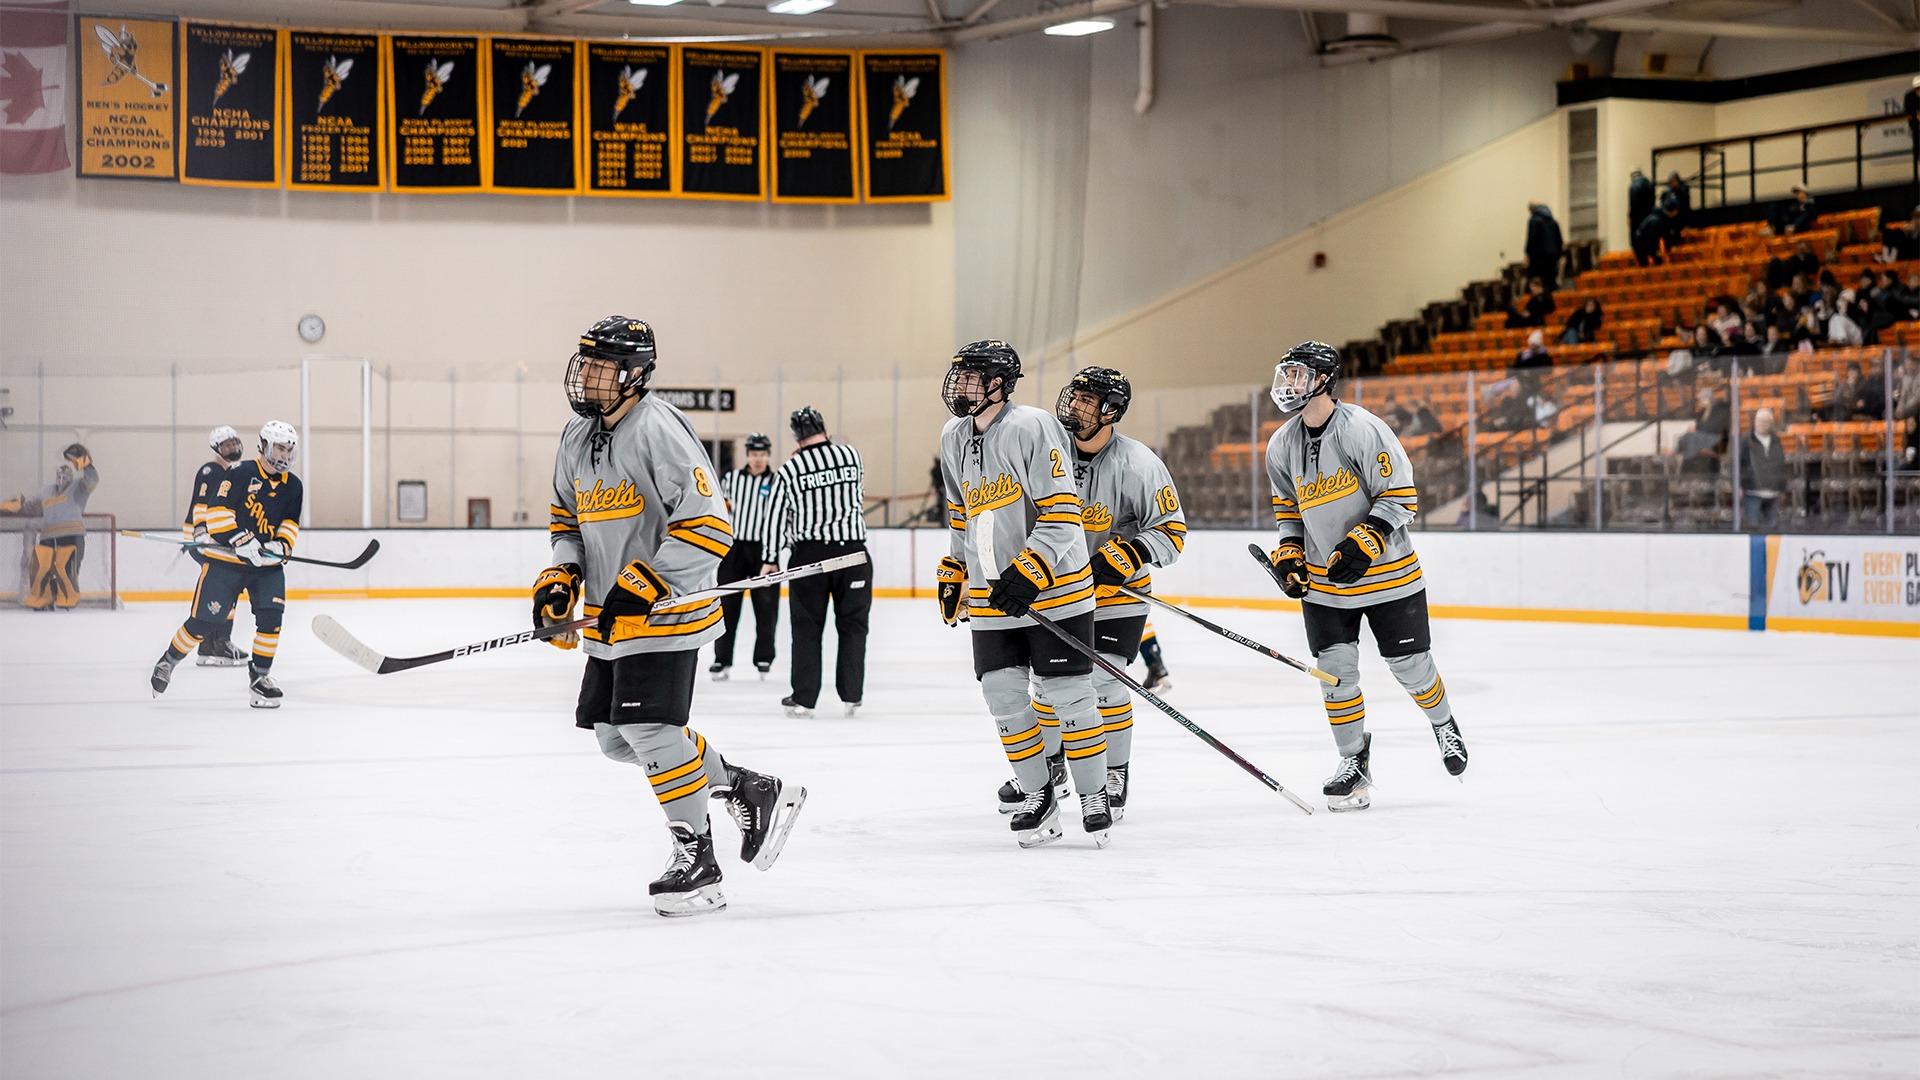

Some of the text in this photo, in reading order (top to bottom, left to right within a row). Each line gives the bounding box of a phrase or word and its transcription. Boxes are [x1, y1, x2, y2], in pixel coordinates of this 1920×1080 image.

[190, 28, 274, 41] YELLOWJACKETS
[87, 101, 169, 111] MEN'S HOCKEY
[213, 108, 250, 119] NCHA
[109, 115, 147, 125] NCAA
[191, 115, 271, 131] CHAMPIONS
[317, 115, 353, 126] NCAA
[431, 118, 473, 126] PLAYOFF
[93, 126, 164, 137] NATIONAL
[301, 125, 370, 134] FROZEN FOUR
[399, 126, 476, 136] CHAMPIONS
[496, 127, 571, 139] CHAMPIONS
[613, 123, 647, 132] WIAC
[235, 130, 264, 141] 2001
[593, 130, 667, 142] CHAMPIONS
[685, 133, 757, 147] CHAMPIONS
[86, 138, 170, 150] CHAMPIONS
[780, 138, 848, 149] CHAMPIONS
[101, 154, 156, 169] 2002
[340, 163, 369, 173] 2001
[698, 392, 705, 408] 1
[720, 392, 731, 408] 2
[1050, 448, 1066, 478] 2
[1377, 451, 1393, 478] 3
[693, 467, 713, 497] 8
[799, 466, 858, 491] FRIEDLIEB
[1155, 485, 1180, 516] 18
[1863, 552, 1902, 577] EVERY
[937, 567, 955, 579] ER
[534, 571, 560, 588] ER
[1825, 560, 1850, 602] TV
[1863, 581, 1902, 605] EVERY
[453, 631, 535, 660] BAUER
[1226, 631, 1261, 650] BAUER
